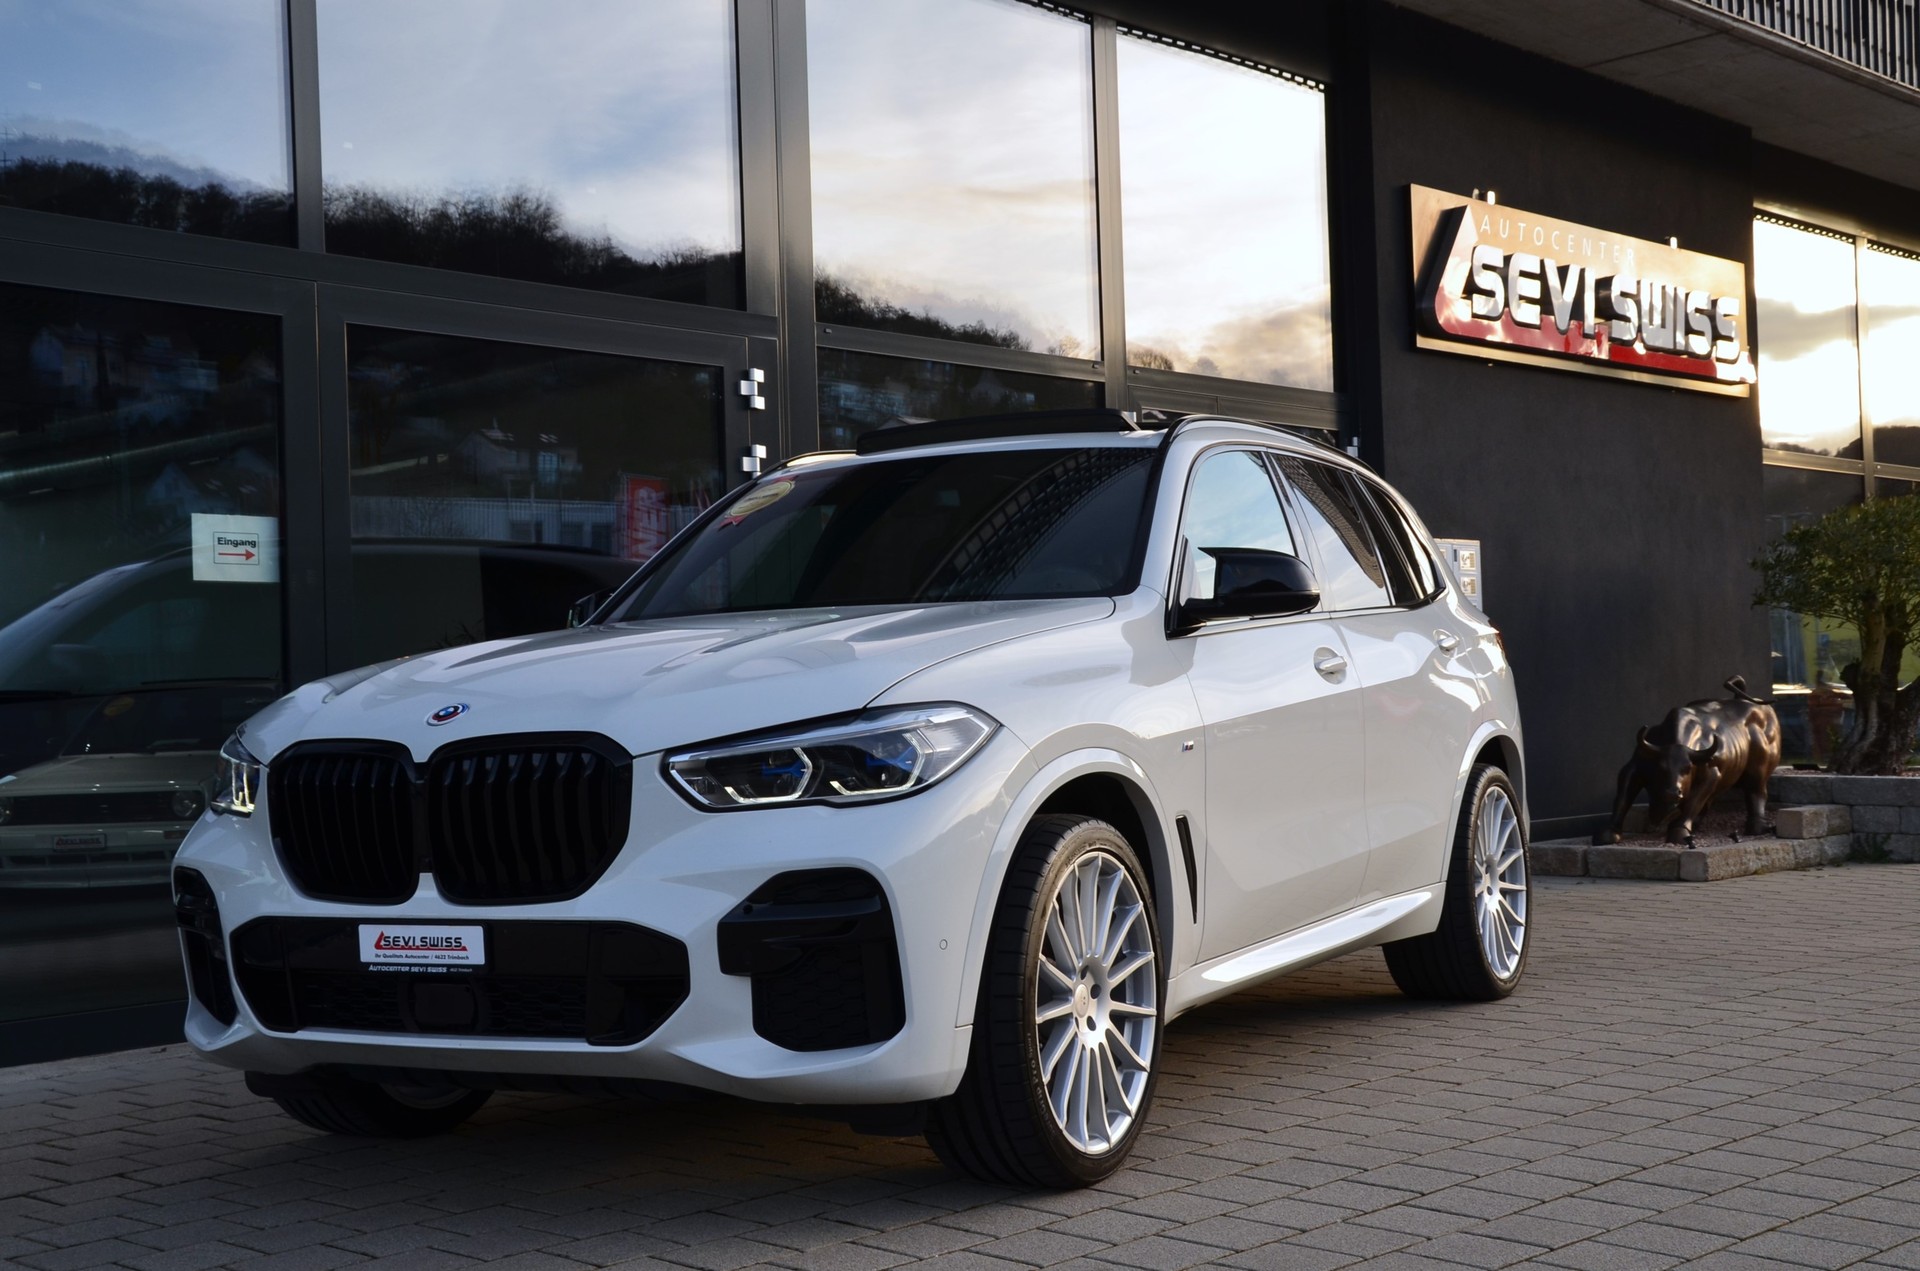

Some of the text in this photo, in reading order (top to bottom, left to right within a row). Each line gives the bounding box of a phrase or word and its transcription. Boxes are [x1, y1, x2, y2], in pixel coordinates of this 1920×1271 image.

[1480, 214, 1635, 267] AUTOCENTER
[1471, 243, 1740, 364] SEVI SWISS
[217, 536, 257, 549] Eingang
[383, 936, 463, 948] SEVI SWISS
